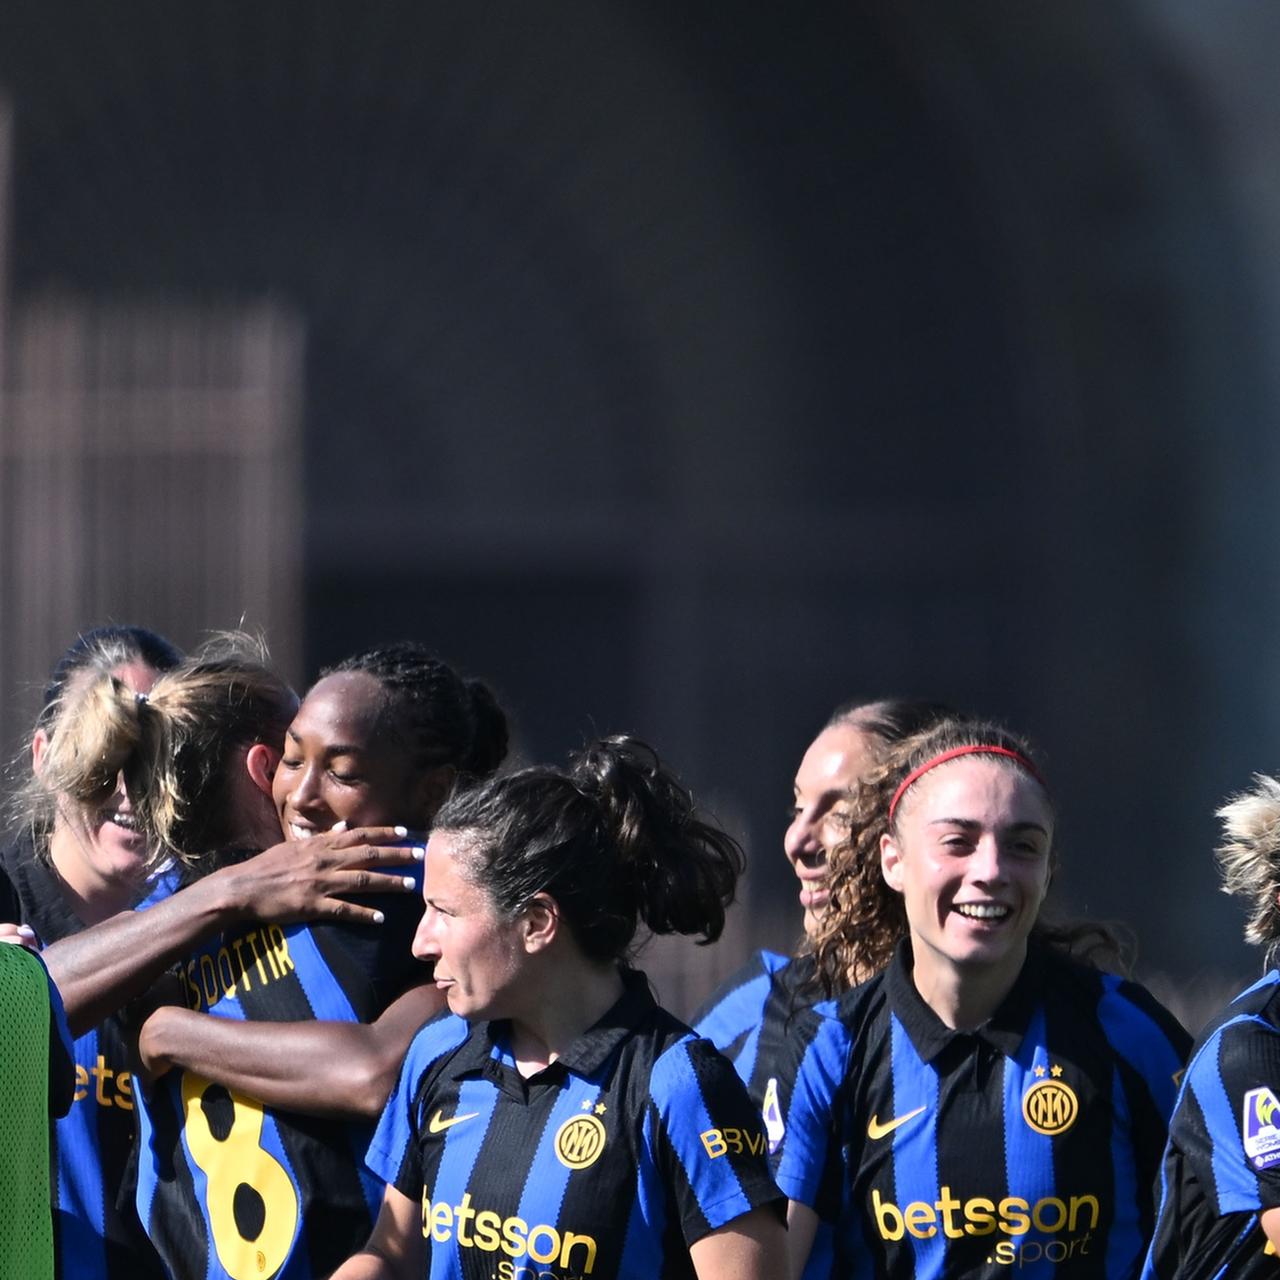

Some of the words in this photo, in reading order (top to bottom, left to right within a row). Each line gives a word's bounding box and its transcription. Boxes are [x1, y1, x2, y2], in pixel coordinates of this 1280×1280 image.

[180, 925, 295, 1012] SDOTTIR
[421, 1184, 598, 1275] betsson
[871, 1185, 1100, 1242] betsson
